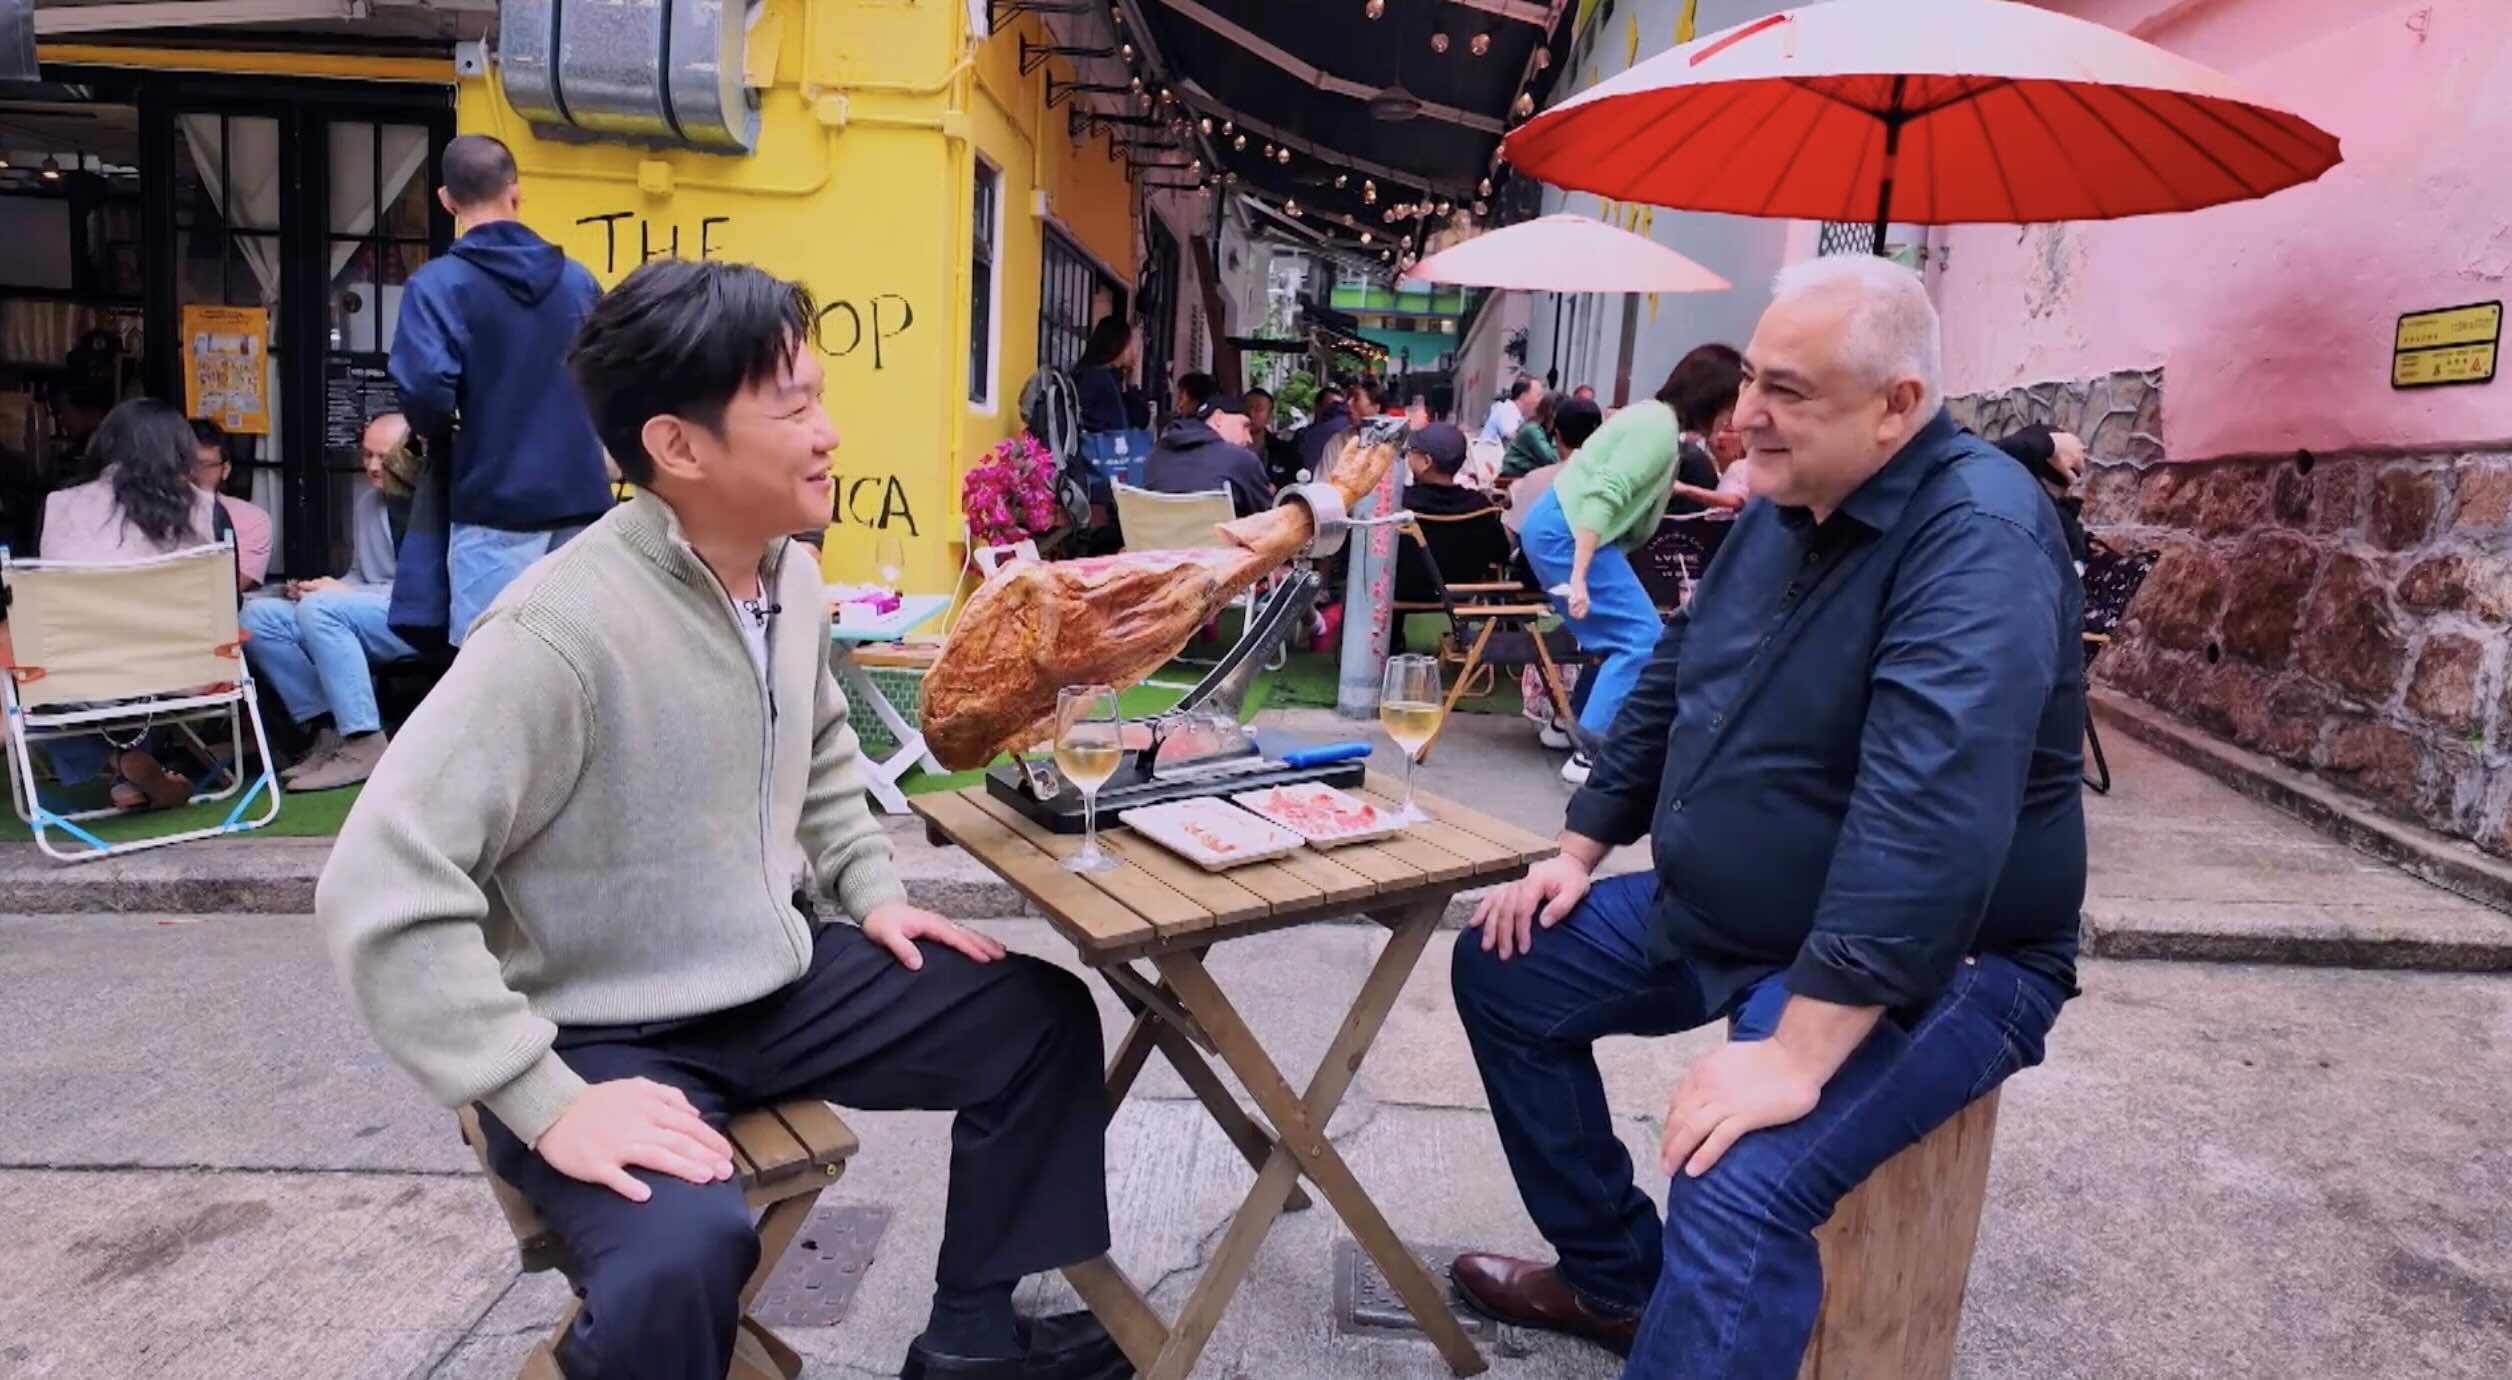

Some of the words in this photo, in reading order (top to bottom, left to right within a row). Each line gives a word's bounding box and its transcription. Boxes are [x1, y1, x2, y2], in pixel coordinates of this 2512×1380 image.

[575, 211, 731, 273] THE
[815, 294, 914, 370] OP
[831, 474, 920, 537] ICA
